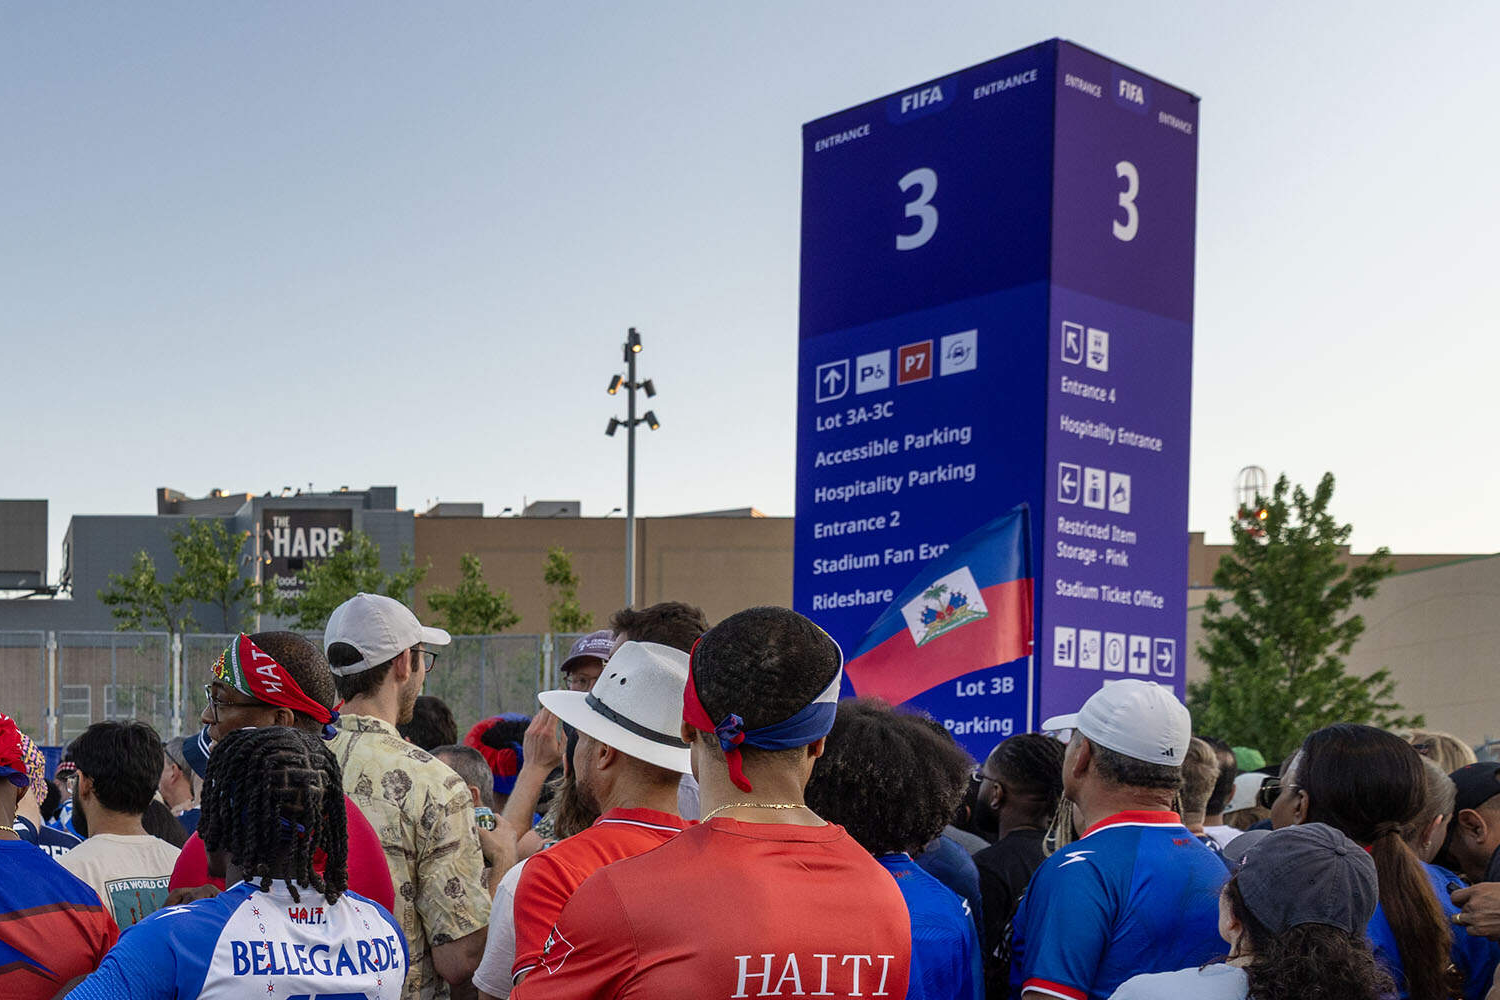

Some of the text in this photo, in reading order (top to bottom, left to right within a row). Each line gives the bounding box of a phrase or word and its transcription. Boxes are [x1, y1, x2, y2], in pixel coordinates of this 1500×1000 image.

[972, 69, 1038, 100] ENTRANCE
[1064, 73, 1102, 98] ENTRANCE
[1118, 79, 1144, 105] FIFA
[900, 85, 944, 114] FIFA
[1158, 111, 1193, 135] ENTRANCE
[814, 123, 871, 152] ENTRANCE
[895, 167, 939, 251] 3
[1112, 160, 1140, 242] 3
[904, 353, 926, 373] P7
[1060, 375, 1117, 403] Entrance 4
[815, 401, 894, 432] Lot 3A-3C
[814, 425, 973, 468] Accessible Parking
[1060, 414, 1163, 451] Hospitality Entrance
[814, 463, 976, 503] Hospitality Parking
[273, 516, 291, 527] THE
[813, 511, 901, 539] Entrance 2
[1057, 516, 1137, 545] Restricted Item
[273, 527, 344, 558] HARP
[1056, 541, 1097, 566] Storage
[1105, 548, 1129, 567] Pink
[812, 552, 880, 575] Stadium
[884, 548, 915, 565] Fan
[812, 587, 893, 611] Rideshare
[1055, 579, 1165, 609] Stadium Ticket Office
[955, 676, 1014, 697] Lot 3B
[944, 716, 1013, 737] Parking
[109, 878, 170, 893] FIFA WORLD CU
[288, 907, 327, 924] HAIT
[230, 935, 399, 976] BELLEGARDE
[731, 953, 895, 999] HAITI
